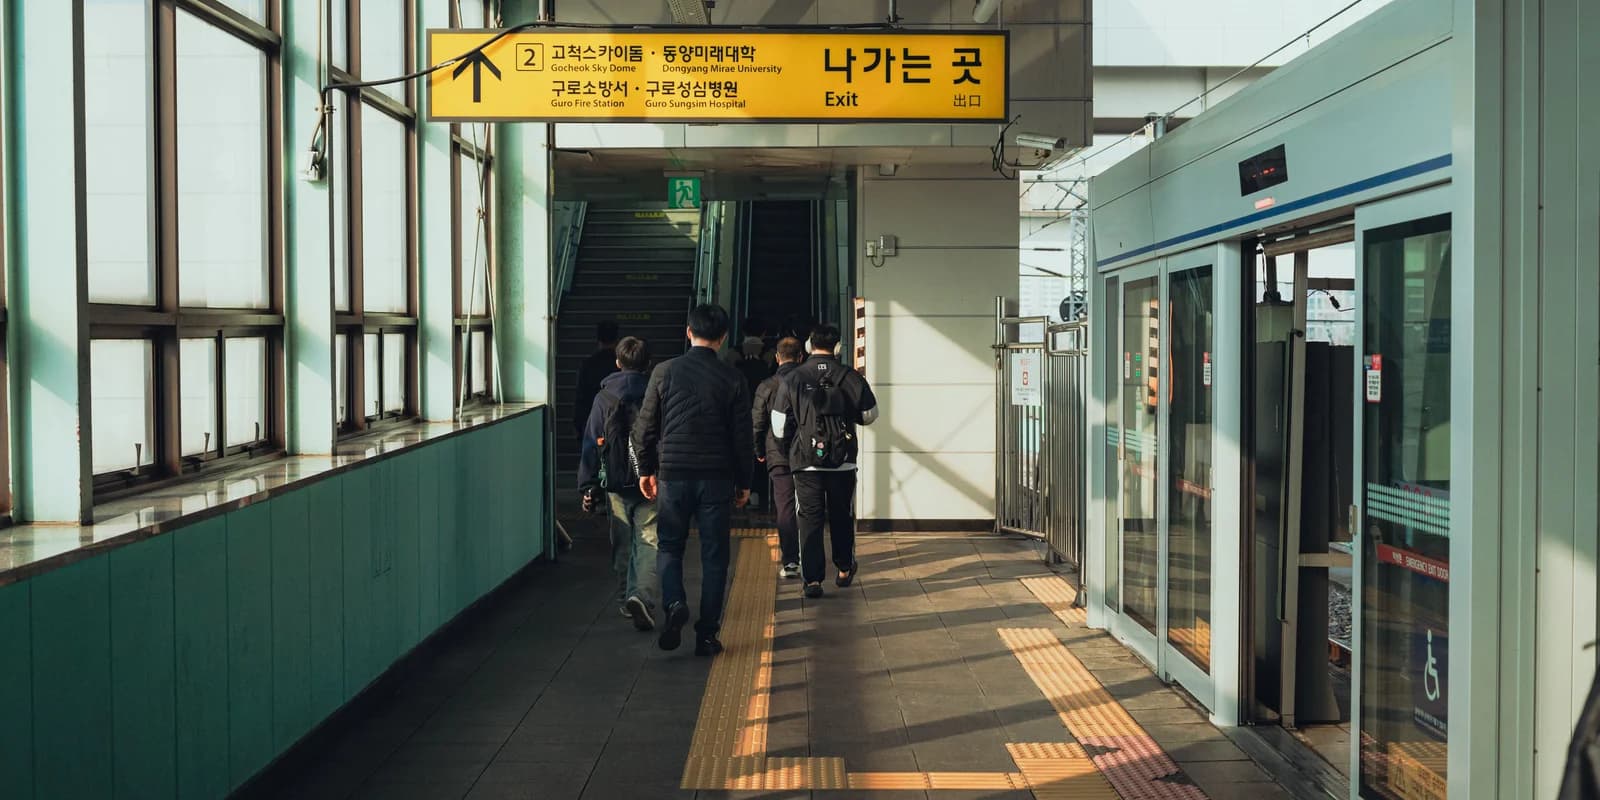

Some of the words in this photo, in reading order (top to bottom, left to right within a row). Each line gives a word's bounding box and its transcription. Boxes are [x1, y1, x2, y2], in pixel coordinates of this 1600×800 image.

[523, 48, 536, 67] 2
[551, 45, 644, 63] 고척스카이돔
[663, 44, 757, 64] 동양미래대학
[551, 63, 590, 72] Gocheok
[592, 63, 608, 74] Sky
[609, 63, 637, 73] Dome
[662, 64, 709, 76] Dongyang
[710, 64, 737, 74] Mirae
[737, 64, 783, 76] University
[824, 47, 933, 84] 나가는
[952, 47, 983, 85] 곳
[551, 80, 629, 98] 구로소방서
[645, 80, 738, 99] 구로성심병원
[551, 98, 573, 108] Guro
[574, 98, 592, 108] Fire
[593, 98, 625, 108] Station
[645, 98, 668, 108] Guro
[669, 98, 708, 110] Sungsim
[709, 98, 746, 110] Hospital
[824, 91, 859, 107] Exit
[952, 93, 982, 108] 出口
